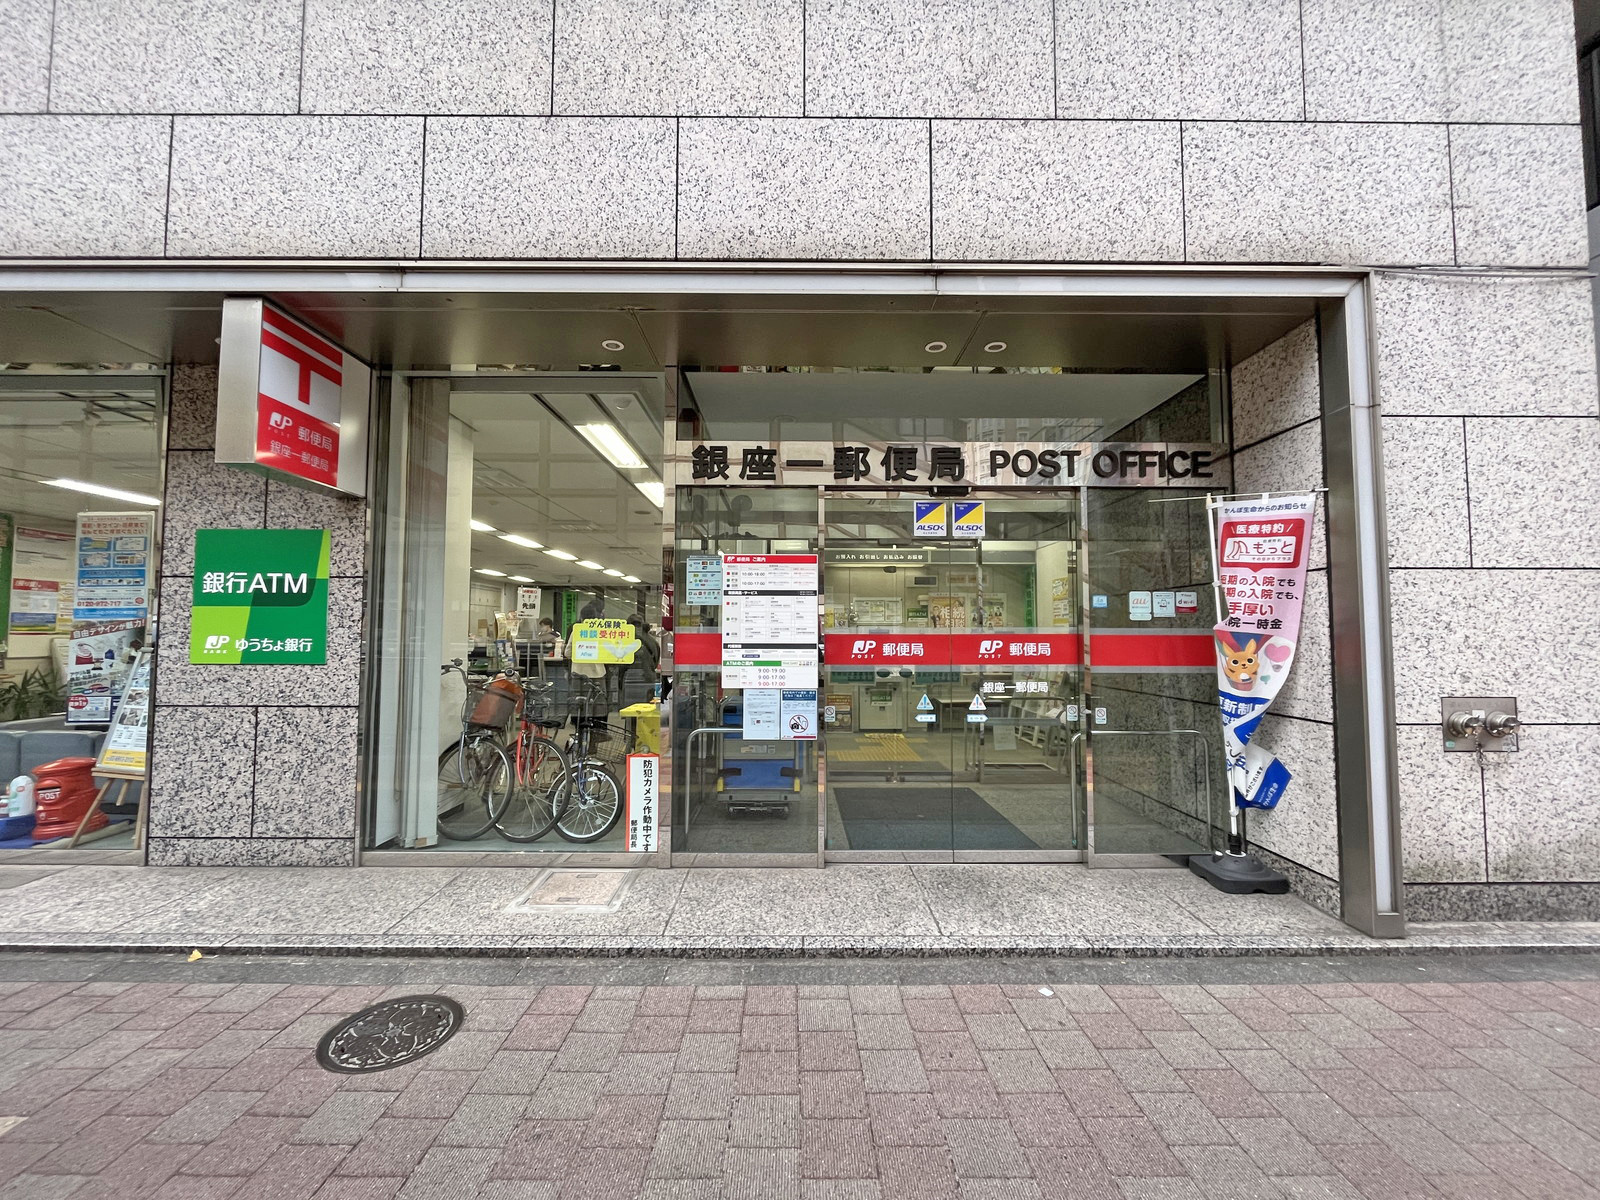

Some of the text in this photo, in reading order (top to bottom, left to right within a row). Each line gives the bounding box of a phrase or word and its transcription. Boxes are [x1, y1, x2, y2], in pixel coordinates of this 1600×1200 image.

[298, 426, 332, 452] 郵便局
[271, 440, 329, 472] 銀座一郵便局
[692, 446, 1213, 481] 銀座一郵便局 POST OFFICE
[1224, 502, 1307, 514] かんぽ生命からのお知らせ
[1236, 523, 1284, 534] 医療特約
[1253, 541, 1293, 554] もっと
[202, 572, 308, 593] 銀行ATM
[1224, 587, 1299, 600] 期の入院でも、
[940, 606, 965, 619] 相続
[1229, 602, 1274, 616] 手厚い
[73, 619, 145, 638] 自由デザインが魅力!
[589, 620, 621, 629] がん保険
[1225, 617, 1283, 629] 院一時金
[580, 630, 630, 639] 相談受付中!
[235, 638, 312, 652] ゆうちょ銀行
[882, 643, 924, 657] 郵便局
[1009, 643, 1051, 657] 郵便局
[983, 682, 1048, 693] 銀座一郵便局
[643, 759, 652, 851] 防犯カメラ作動中です
[630, 820, 638, 848] 郵便局長
